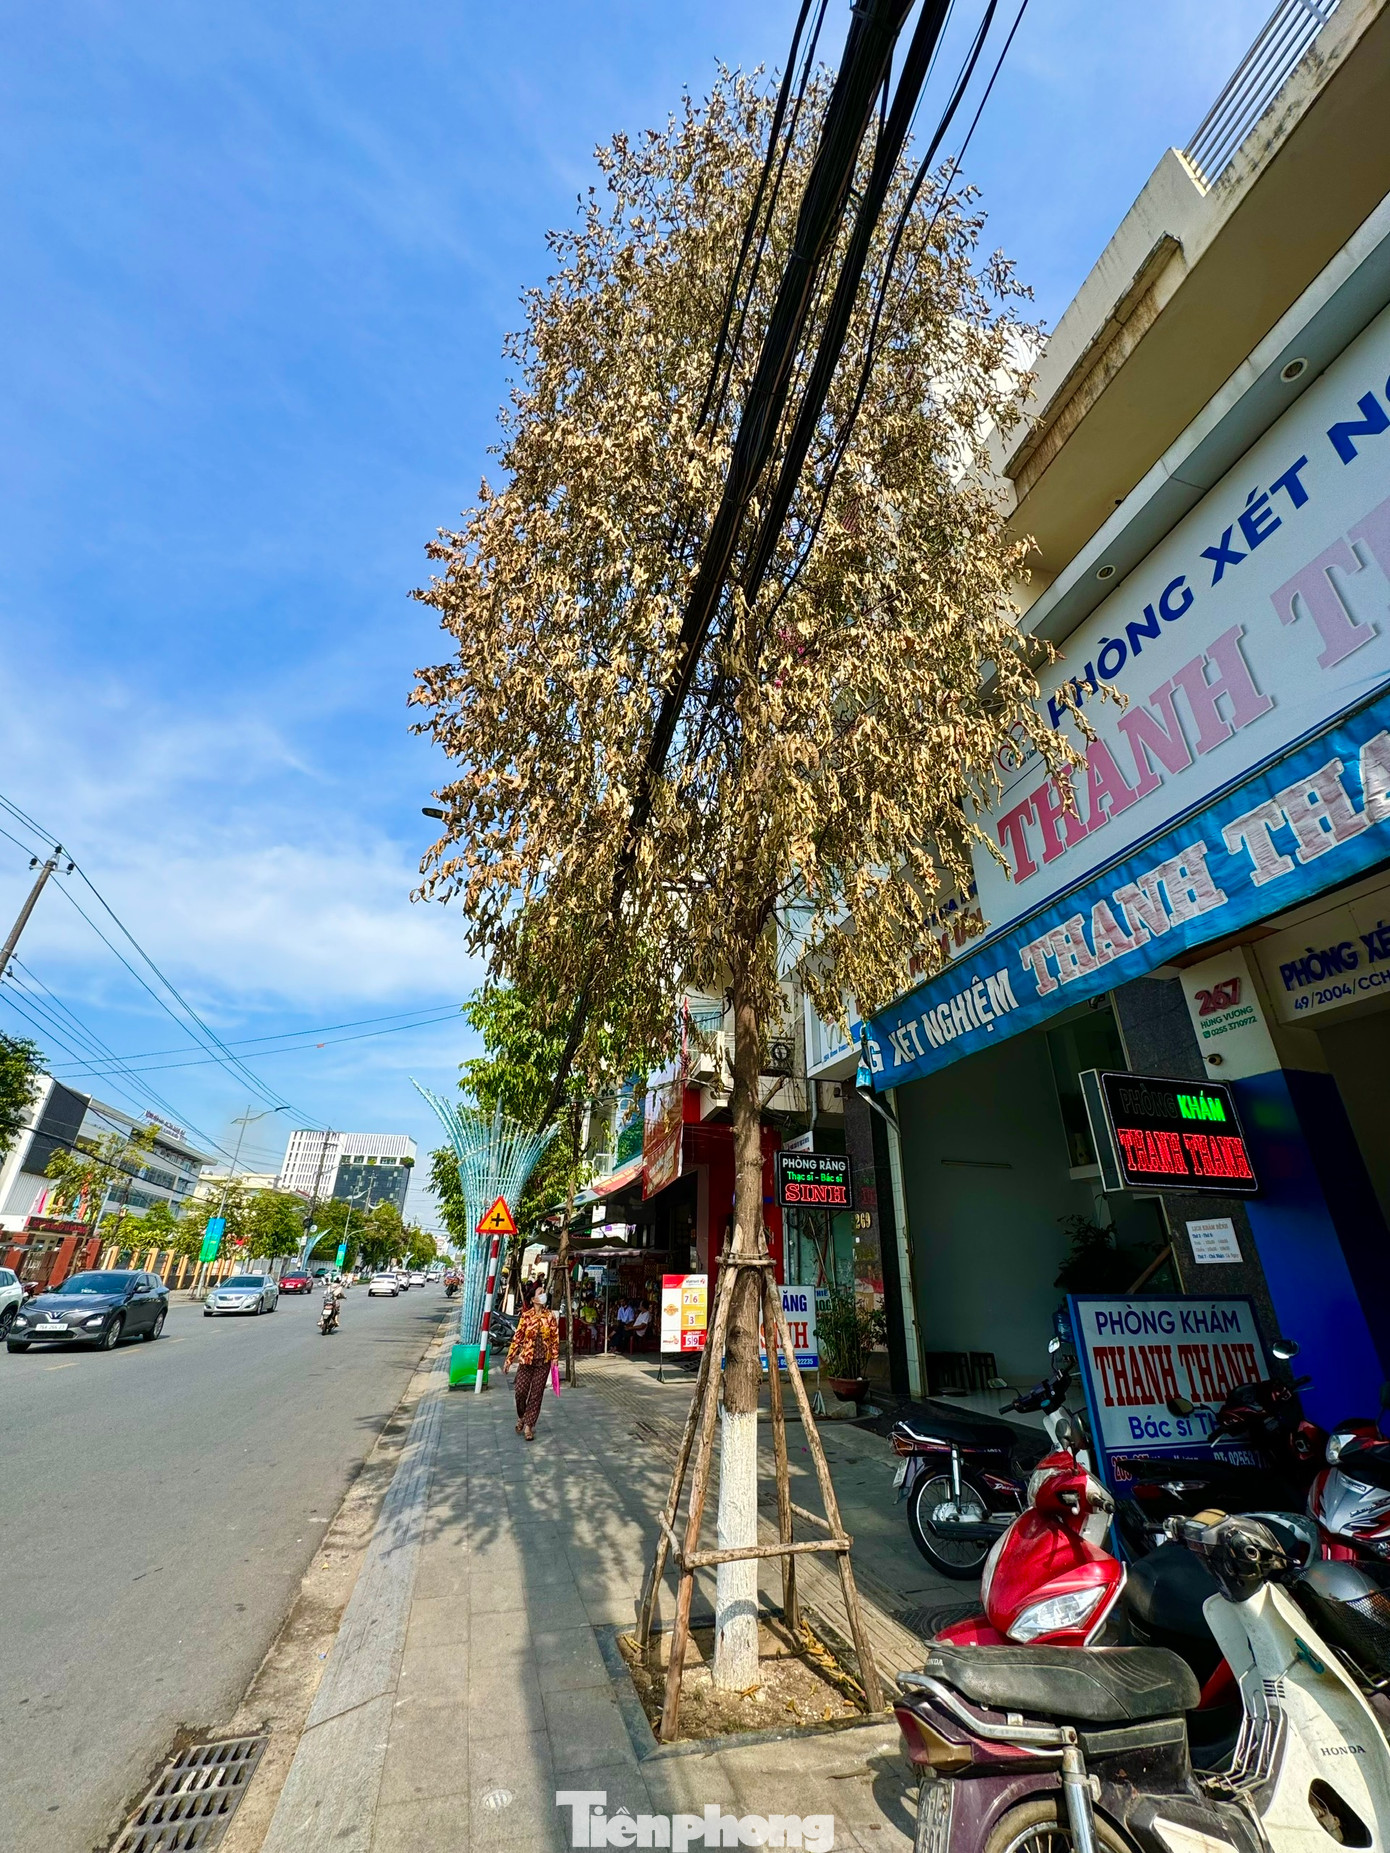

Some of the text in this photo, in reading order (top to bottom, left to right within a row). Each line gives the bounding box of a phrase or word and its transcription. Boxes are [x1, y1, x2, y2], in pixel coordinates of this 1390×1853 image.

[1046, 574, 1195, 729] PHÒNG
[1200, 454, 1309, 587] XÉT
[997, 623, 1275, 886] THANH
[888, 1019, 925, 1067] XÉT
[921, 968, 1020, 1049] NGHIỆM
[1019, 840, 1228, 996] THANH
[1279, 941, 1359, 992] PHÒNG
[1194, 976, 1242, 1017] 267
[1200, 1005, 1254, 1029] HÙNG VƯƠNG
[1211, 1015, 1258, 1036] 0255 3710972
[1118, 1083, 1226, 1121] PHÒNG KHÁM
[782, 1156, 846, 1171] PHÒNG RĂNG
[1117, 1128, 1253, 1179] THANH THANH
[787, 1171, 805, 1182] Thạc
[820, 1173, 834, 1182] Bác
[785, 1183, 847, 1203] SINH
[855, 1212, 871, 1229] 269
[1095, 1304, 1241, 1335] PHÒNG KHÁM
[1093, 1343, 1262, 1407] THANH THANH
[1128, 1415, 1172, 1439] Bác
[1320, 1745, 1366, 1756] HONDA
